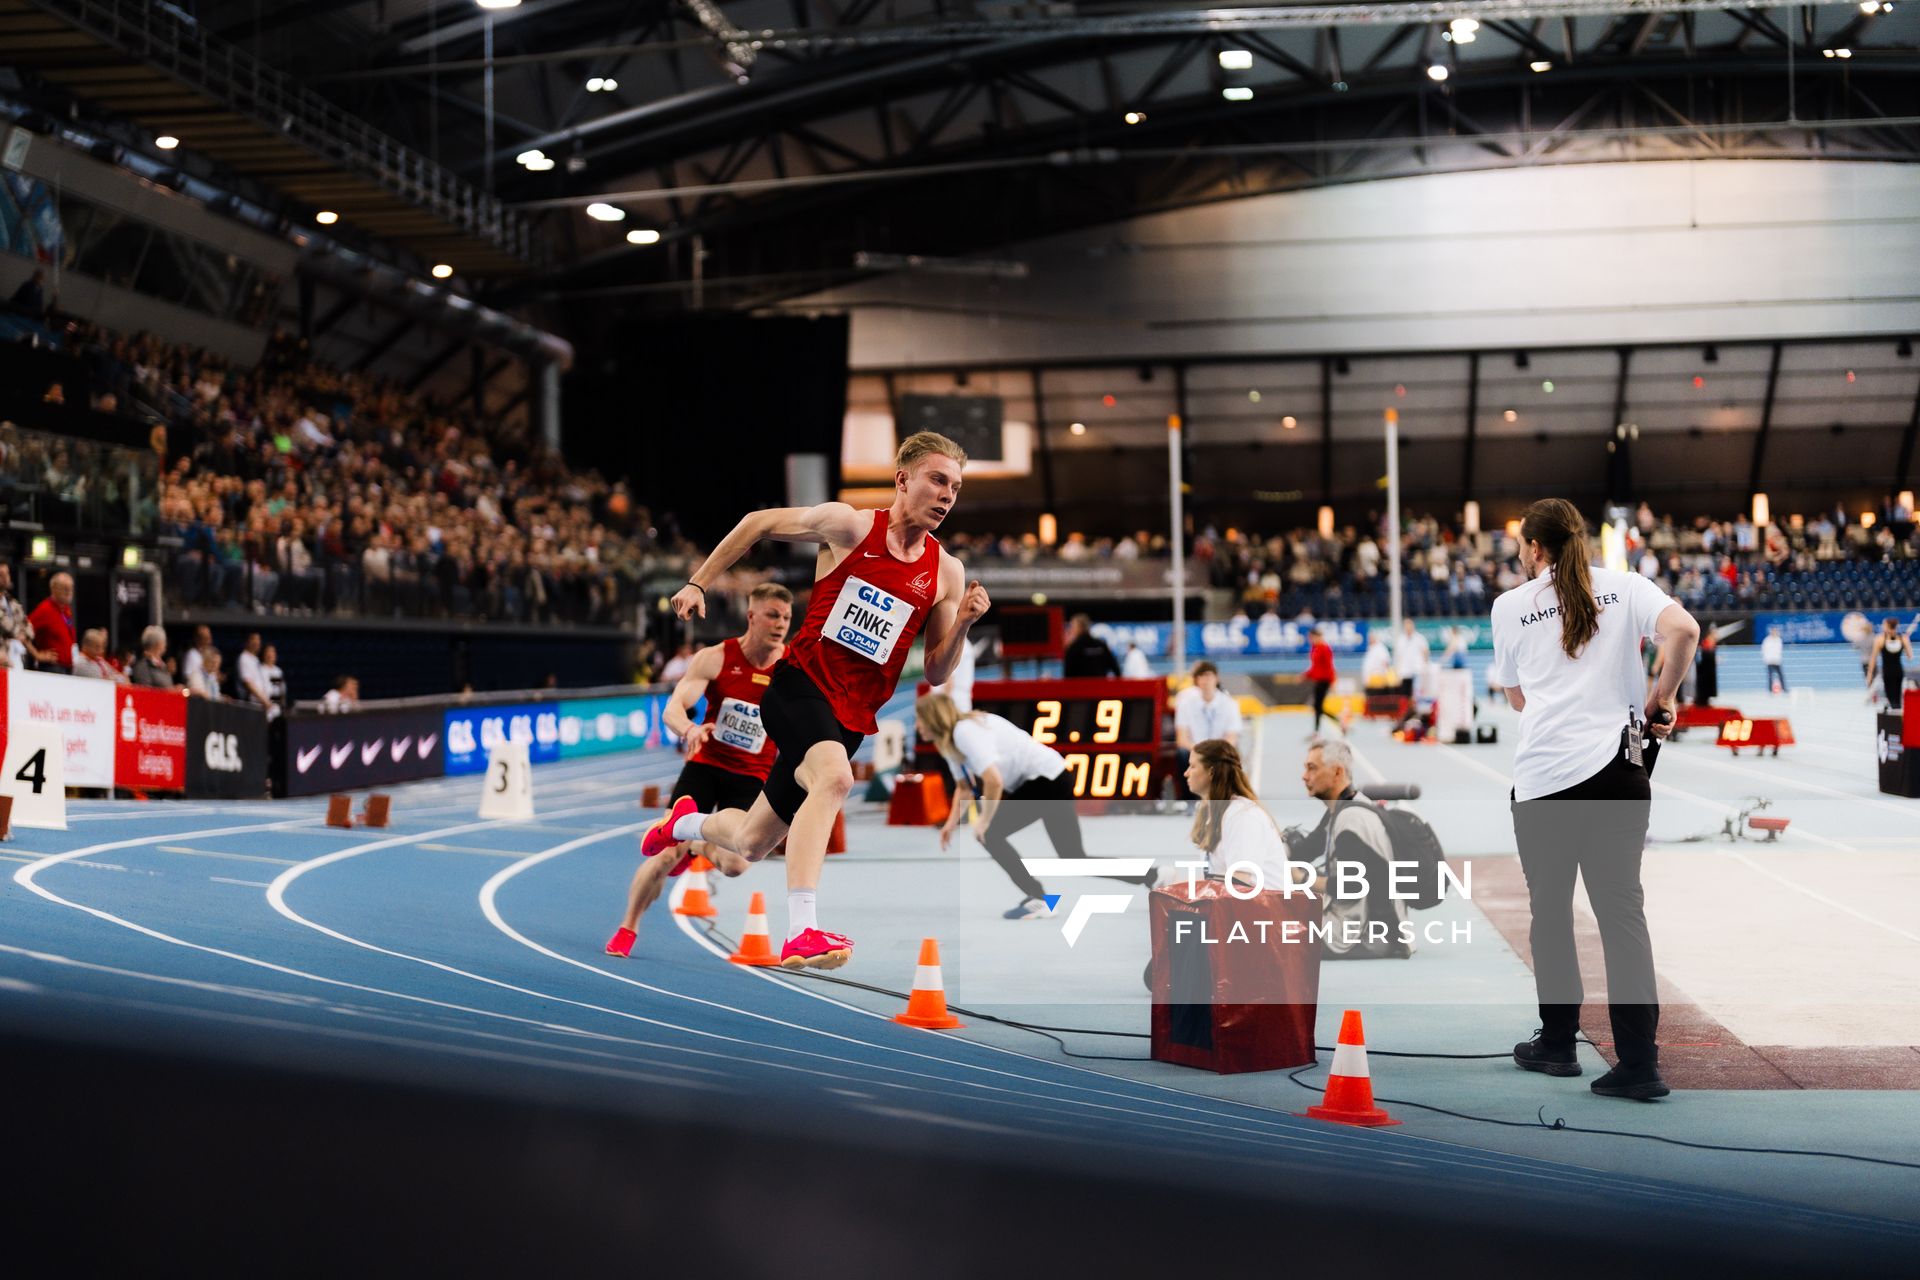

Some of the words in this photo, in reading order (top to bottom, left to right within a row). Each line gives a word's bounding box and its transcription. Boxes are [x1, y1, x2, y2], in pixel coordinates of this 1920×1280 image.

[843, 602, 894, 641] FINKE
[1520, 593, 1619, 627] KAMPFTER
[855, 635, 878, 651] PLAN
[139, 718, 186, 747] Sparkasse
[722, 712, 763, 738] KOLBERG
[1032, 700, 1123, 744] 2.9
[15, 748, 46, 794] 4
[138, 750, 173, 780] Leipzig
[494, 761, 508, 793] 3
